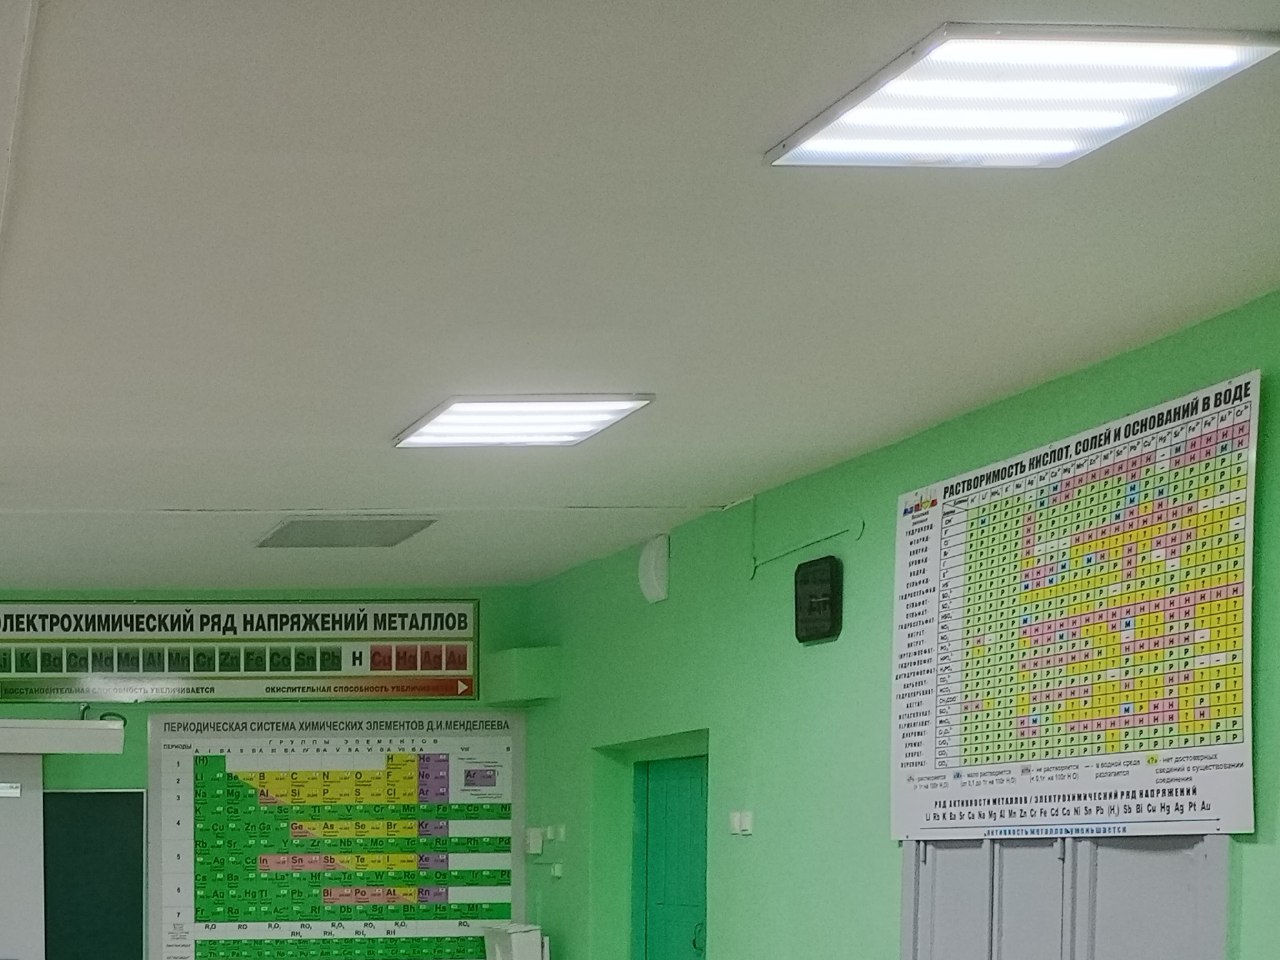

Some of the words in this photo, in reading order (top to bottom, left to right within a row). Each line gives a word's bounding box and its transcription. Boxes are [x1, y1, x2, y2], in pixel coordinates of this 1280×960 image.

[943, 460, 1026, 500] РАСТВОРИМОСТЬ
[1029, 444, 1072, 471] КИСЛОТ,
[1074, 428, 1111, 456] СОЛЕЙ
[1113, 425, 1121, 438] И
[1124, 397, 1199, 438] ОСНОВАНИЙ
[1202, 396, 1210, 412] В
[1213, 381, 1252, 408] ВОДЕ
[200, 613, 237, 635] РЯД
[243, 608, 368, 632] НАПРЯЖЕНИЙ
[373, 612, 468, 632] МЕТАЛЛОВ
[20, 652, 31, 669] K
[195, 652, 214, 668] Cr
[220, 652, 239, 668] Zn
[246, 651, 264, 667] Fe
[295, 651, 315, 667] Sn
[321, 651, 341, 667] Pb
[351, 650, 363, 667] H
[371, 650, 392, 666] Cu
[163, 721, 248, 734] ПЕРИОДИЧЕСКАЯ
[250, 721, 296, 732] СИСТЕМА
[298, 720, 364, 732] ХИМИЧЕСКИХ
[366, 720, 424, 731] ЭЛЕМЕНТОВ
[426, 720, 510, 732] Д.И.МЕНДЕЛЕЕВА
[195, 756, 208, 766] (H)
[386, 754, 393, 762] H
[259, 772, 265, 780] B
[291, 772, 298, 780] C
[323, 772, 329, 780] N
[355, 771, 362, 779] O
[387, 771, 392, 779] F
[195, 789, 207, 798] Na
[227, 789, 241, 799] Mg
[291, 789, 300, 797] Si
[355, 788, 360, 796] S
[1034, 790, 1119, 804] ЭЛЕКТРОХИМИЧЕСКИЙ
[1120, 790, 1137, 800] РЯД
[1138, 785, 1197, 799] НАПРЯЖЕНИЙ
[195, 806, 202, 815] K
[227, 806, 239, 814] Ca
[374, 805, 384, 813] Cr
[1020, 809, 1027, 818] Zn
[1040, 808, 1047, 817] Fe
[1050, 807, 1059, 817] Cd
[1062, 807, 1070, 816] Co
[1096, 806, 1104, 815] Pb
[1123, 804, 1132, 814] Sb
[1136, 804, 1143, 813] Bi
[1147, 804, 1156, 813] Cu
[1160, 803, 1170, 815] Hg
[1174, 802, 1184, 814] Ag
[1188, 802, 1196, 812] Pt
[1201, 801, 1211, 811] Au
[212, 823, 224, 831] Cu
[245, 823, 256, 831] Zn
[419, 821, 428, 829] Kr
[195, 840, 207, 848] Rb
[340, 839, 352, 847] Nb
[212, 857, 225, 865] Ag
[244, 857, 257, 865] Cd
[259, 856, 267, 864] In
[291, 856, 303, 864] Sn
[323, 856, 335, 864] Sb
[227, 873, 239, 881] Ba
[375, 872, 384, 880] W
[291, 889, 303, 897] Pb
[418, 888, 429, 896] Rn
